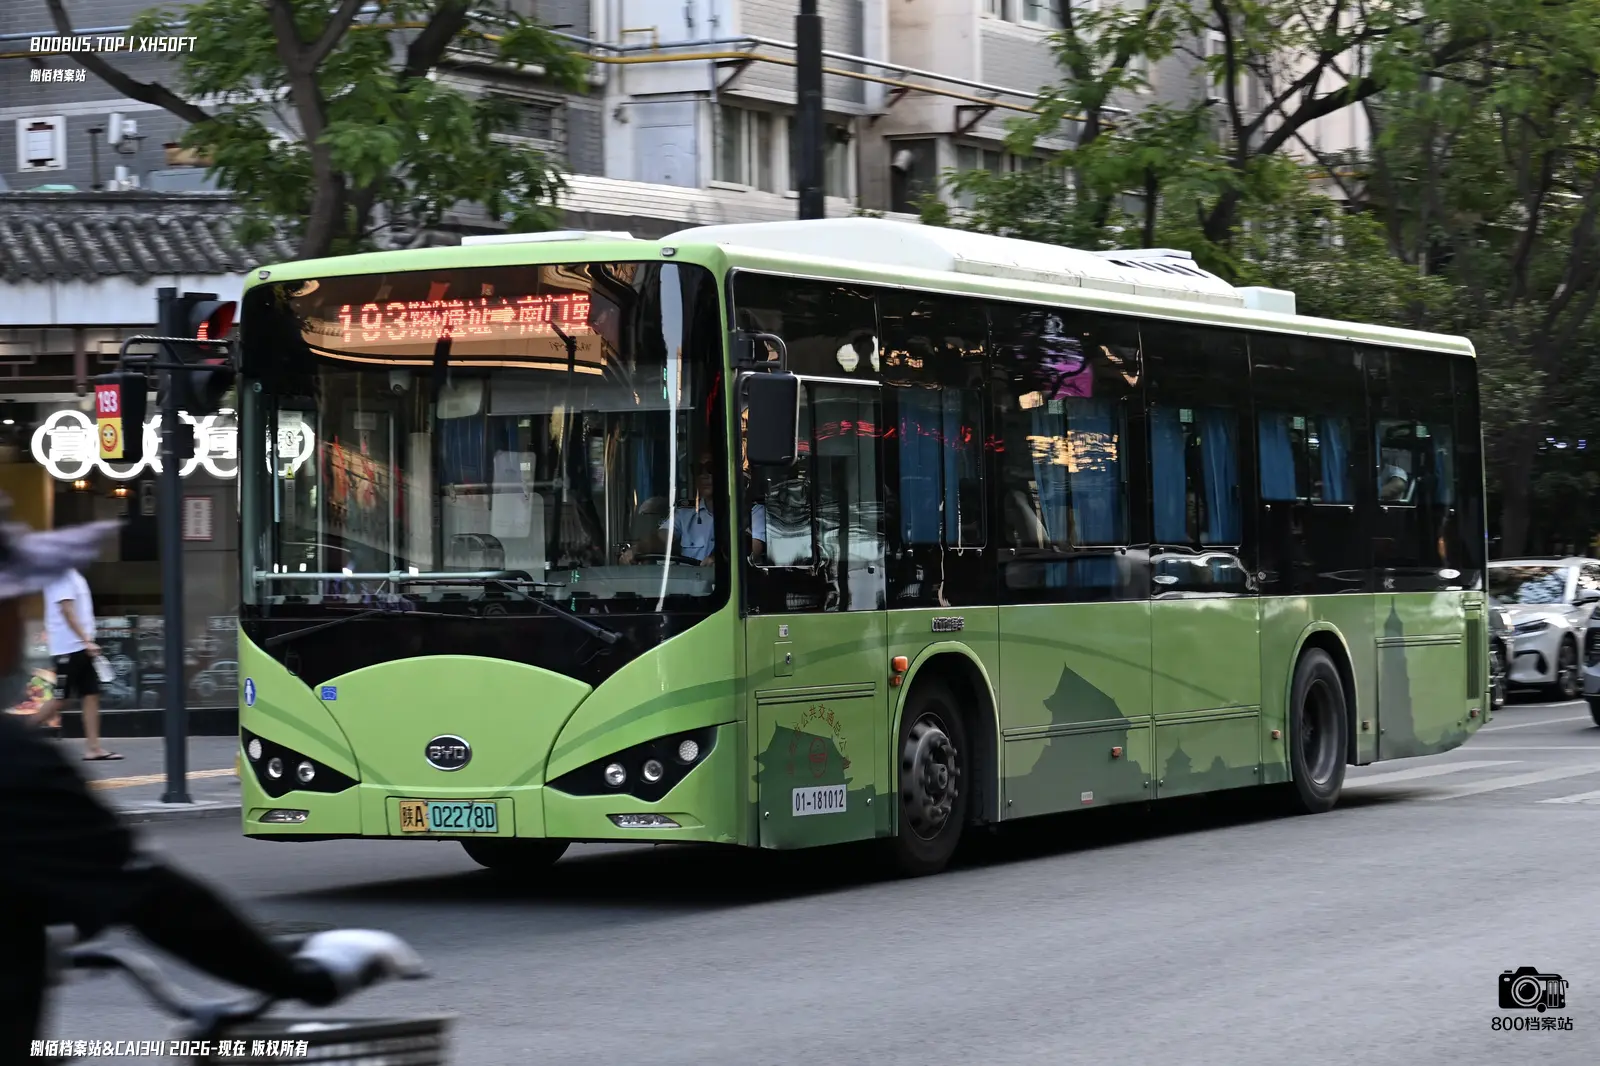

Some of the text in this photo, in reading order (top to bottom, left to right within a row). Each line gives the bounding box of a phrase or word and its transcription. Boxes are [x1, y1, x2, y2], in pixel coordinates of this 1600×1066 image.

[98, 390, 118, 413] 193
[430, 745, 466, 760] BYD
[795, 789, 844, 811] 01-181012
[402, 804, 495, 829] 陕A 02278D
